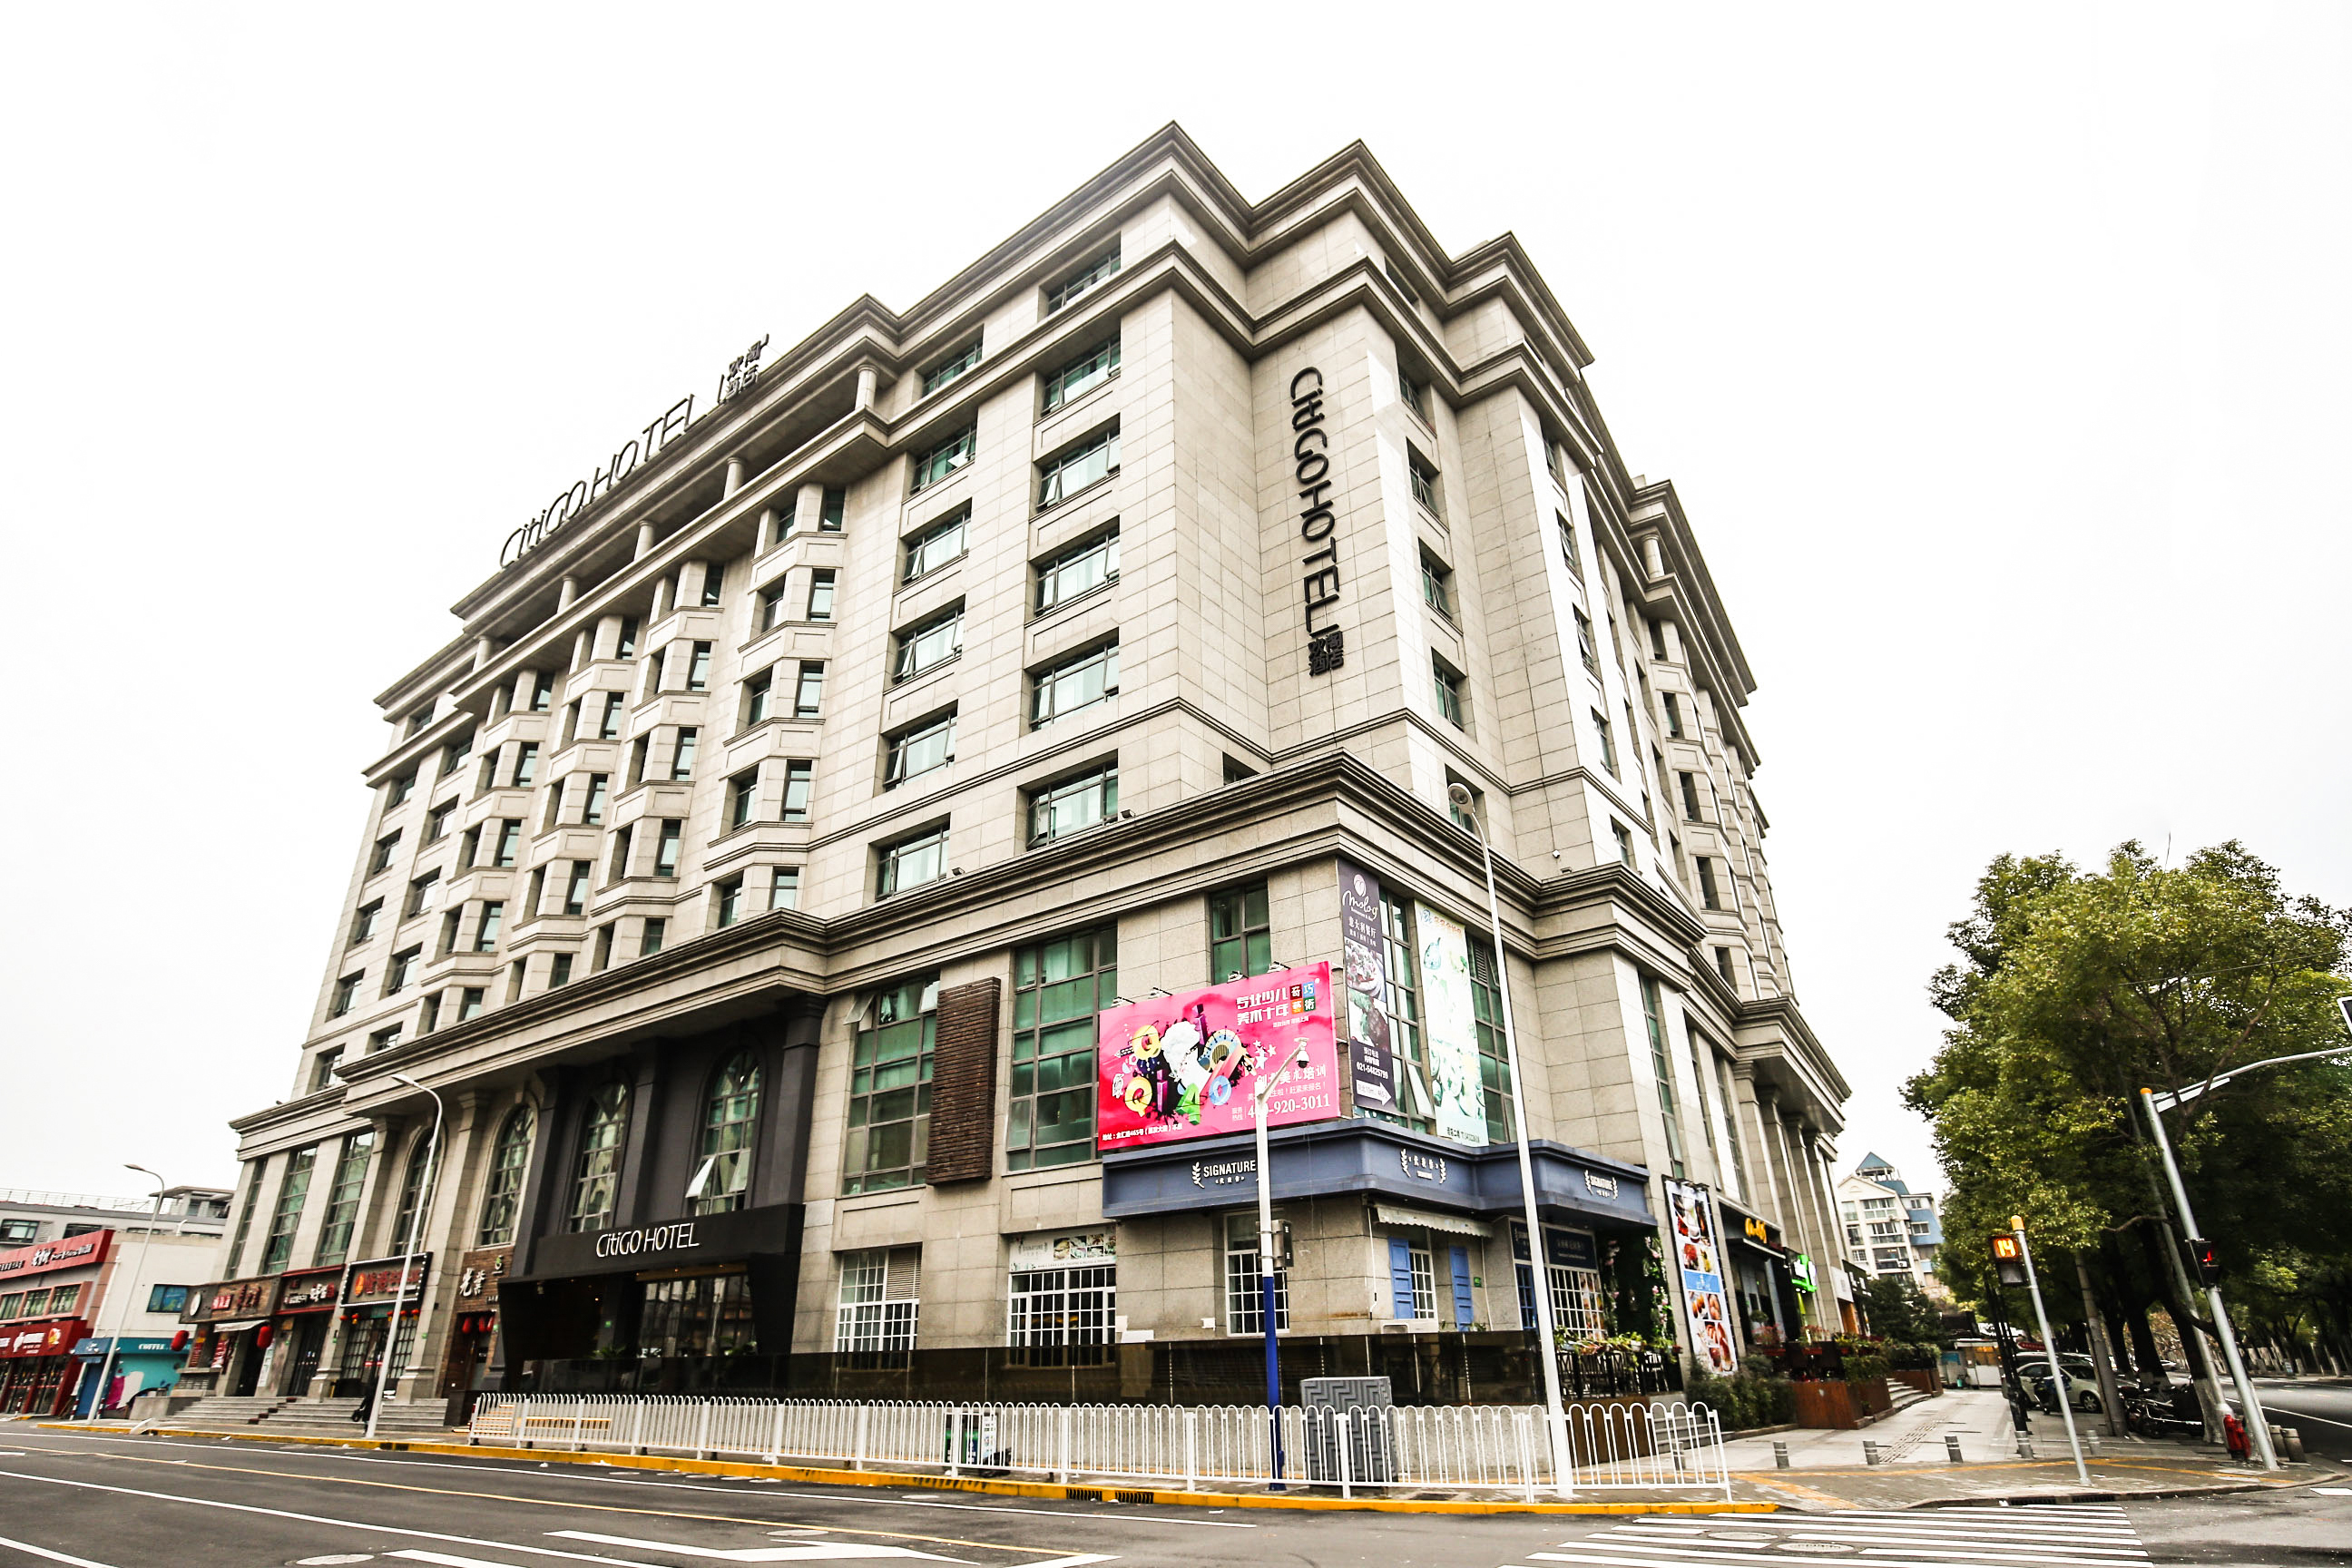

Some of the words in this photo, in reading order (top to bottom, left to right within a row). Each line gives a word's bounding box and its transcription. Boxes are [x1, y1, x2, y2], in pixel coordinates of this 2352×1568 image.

[589, 393, 707, 504] HOTEL
[1299, 479, 1340, 633] HOTEL
[1248, 1093, 1331, 1119] 4-920-3011
[1203, 1160, 1257, 1178] SIGNATURE
[642, 1222, 701, 1252] HOTEL
[1997, 1239, 2016, 1257] 14
